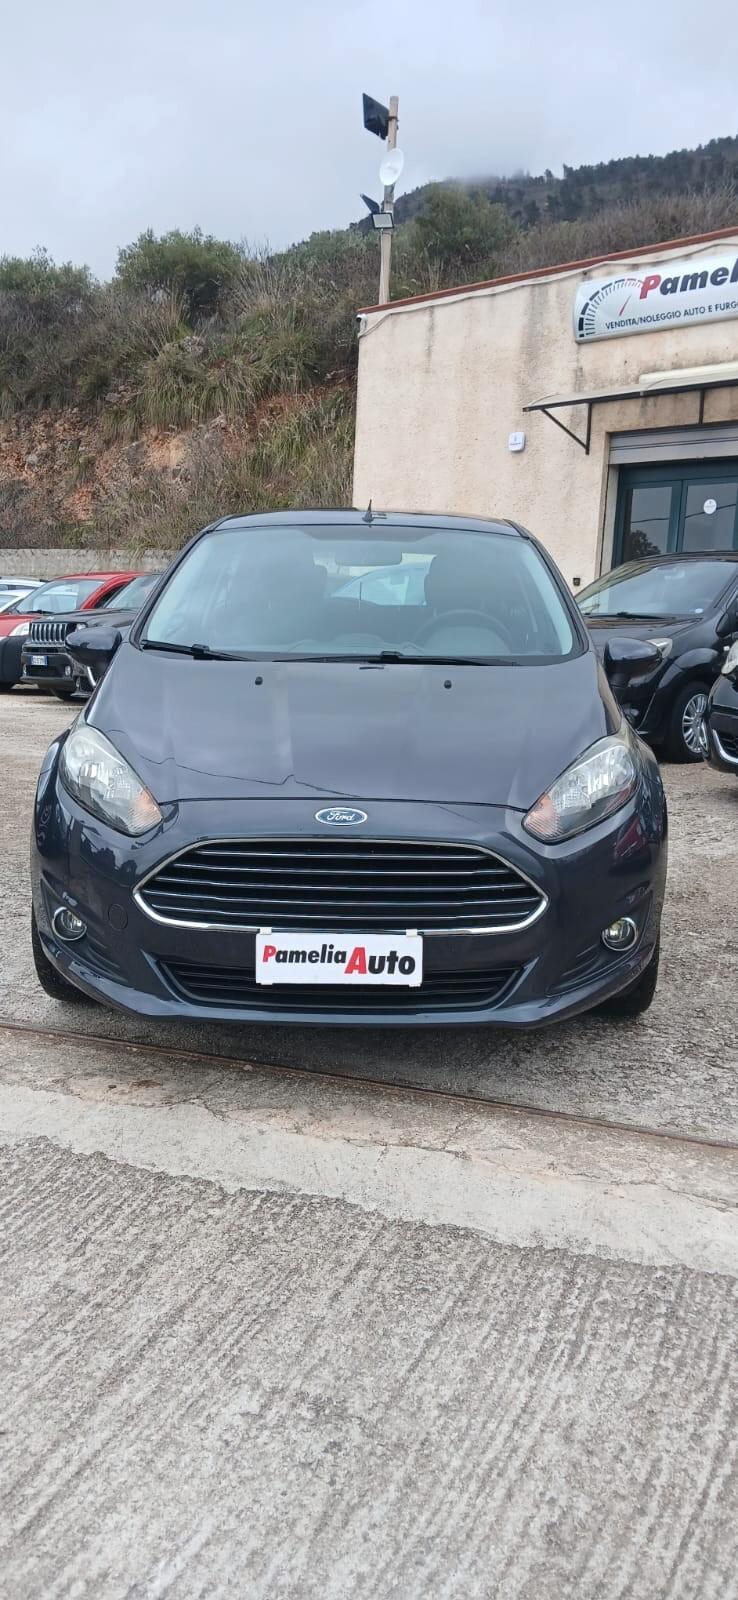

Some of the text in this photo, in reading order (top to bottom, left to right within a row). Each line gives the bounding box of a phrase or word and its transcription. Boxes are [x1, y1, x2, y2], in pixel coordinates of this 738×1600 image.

[683, 306, 705, 317] AUTO
[708, 305, 713, 313] E
[715, 300, 738, 312] FURG
[327, 810, 355, 821] Ford
